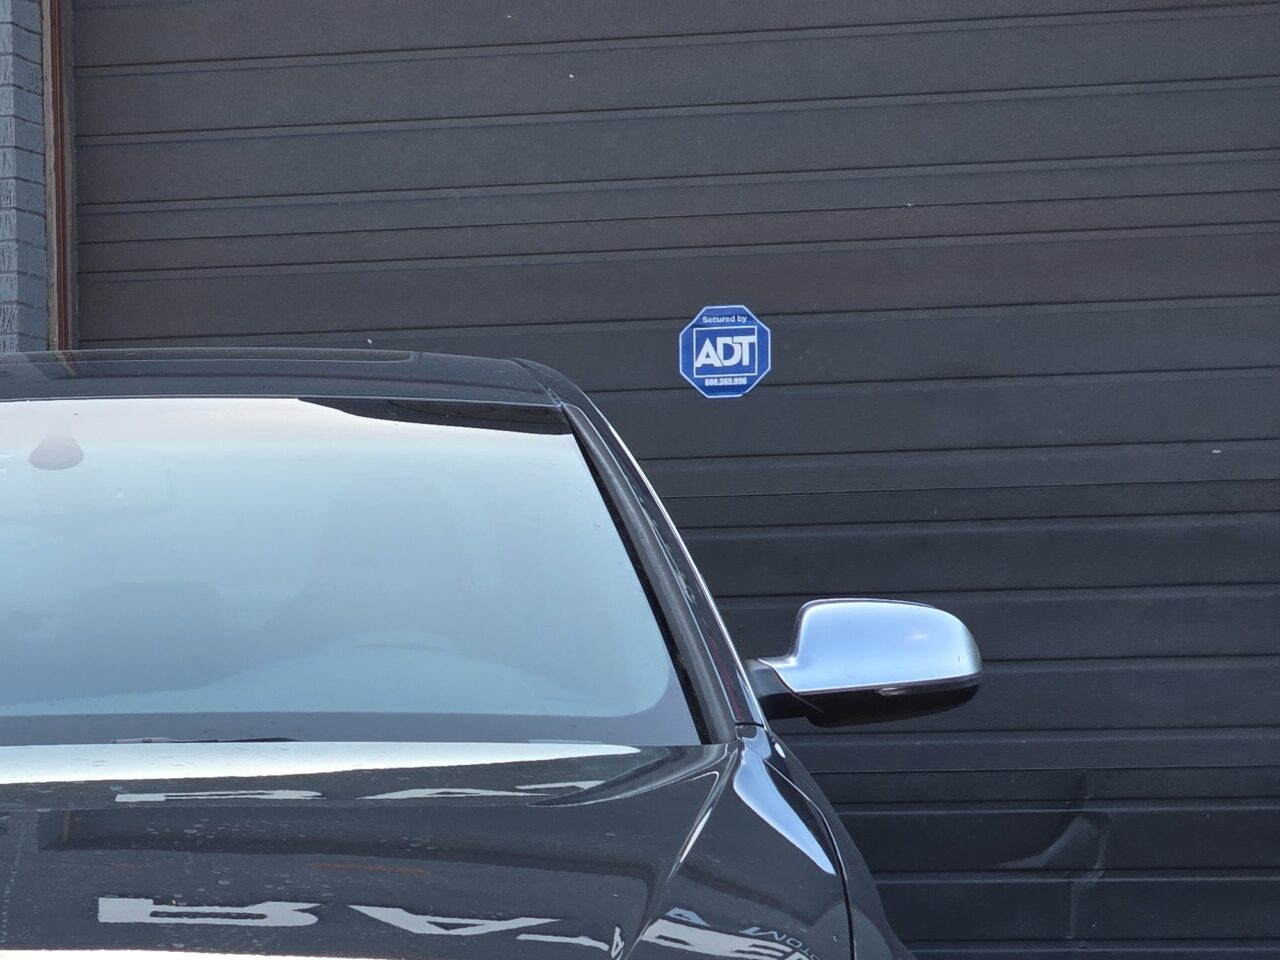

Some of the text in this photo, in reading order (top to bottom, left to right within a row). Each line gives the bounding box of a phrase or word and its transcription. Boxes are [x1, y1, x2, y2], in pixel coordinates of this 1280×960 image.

[702, 314, 747, 324] Secured by
[695, 335, 757, 368] ADT
